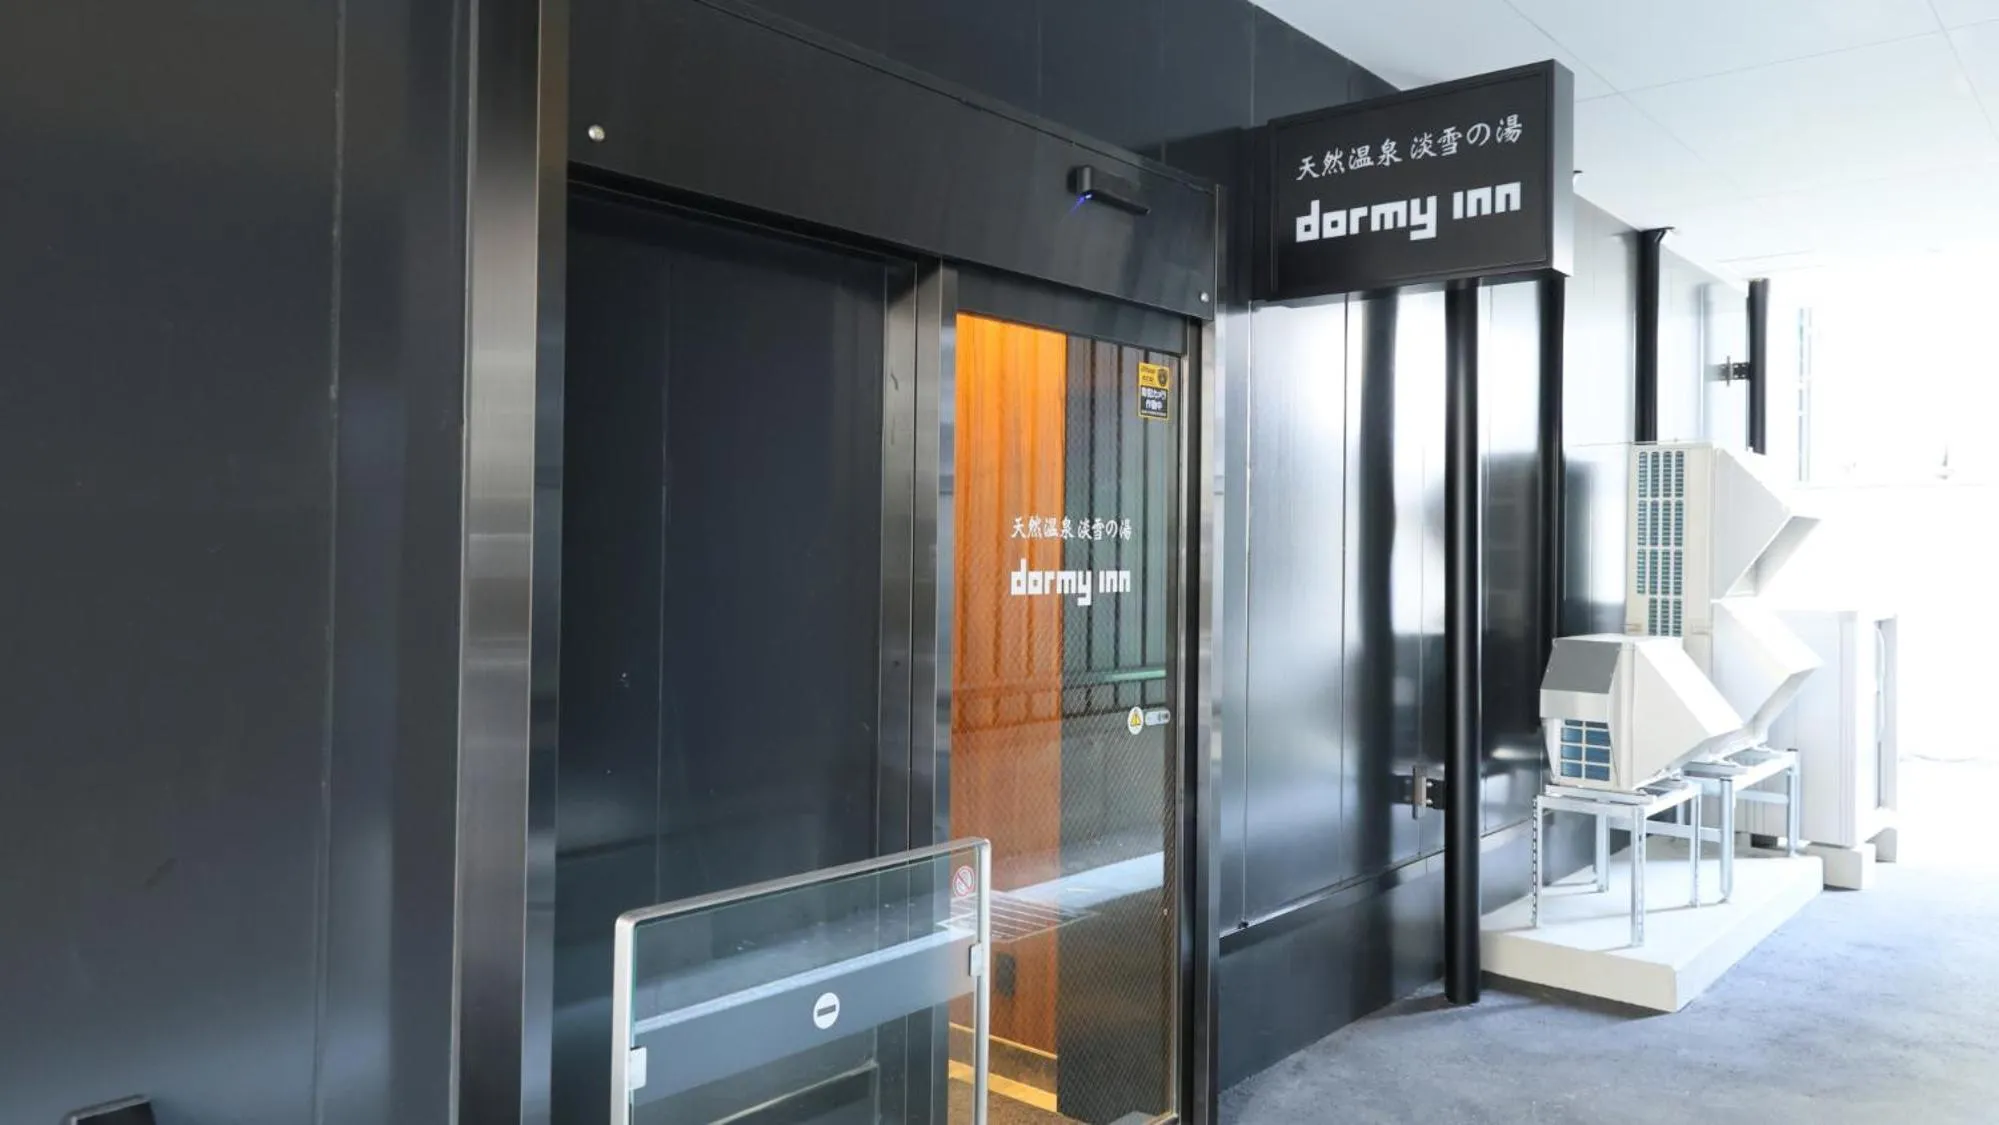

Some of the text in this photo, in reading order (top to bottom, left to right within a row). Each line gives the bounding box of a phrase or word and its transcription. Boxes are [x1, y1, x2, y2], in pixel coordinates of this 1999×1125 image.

[1296, 113, 1523, 181] 天然温泉 淡雪の湯
[1296, 181, 1521, 243] dormy inn
[1011, 515, 1132, 541] 天然温泉 淡雪の湯
[1010, 557, 1131, 606] dormy inn
